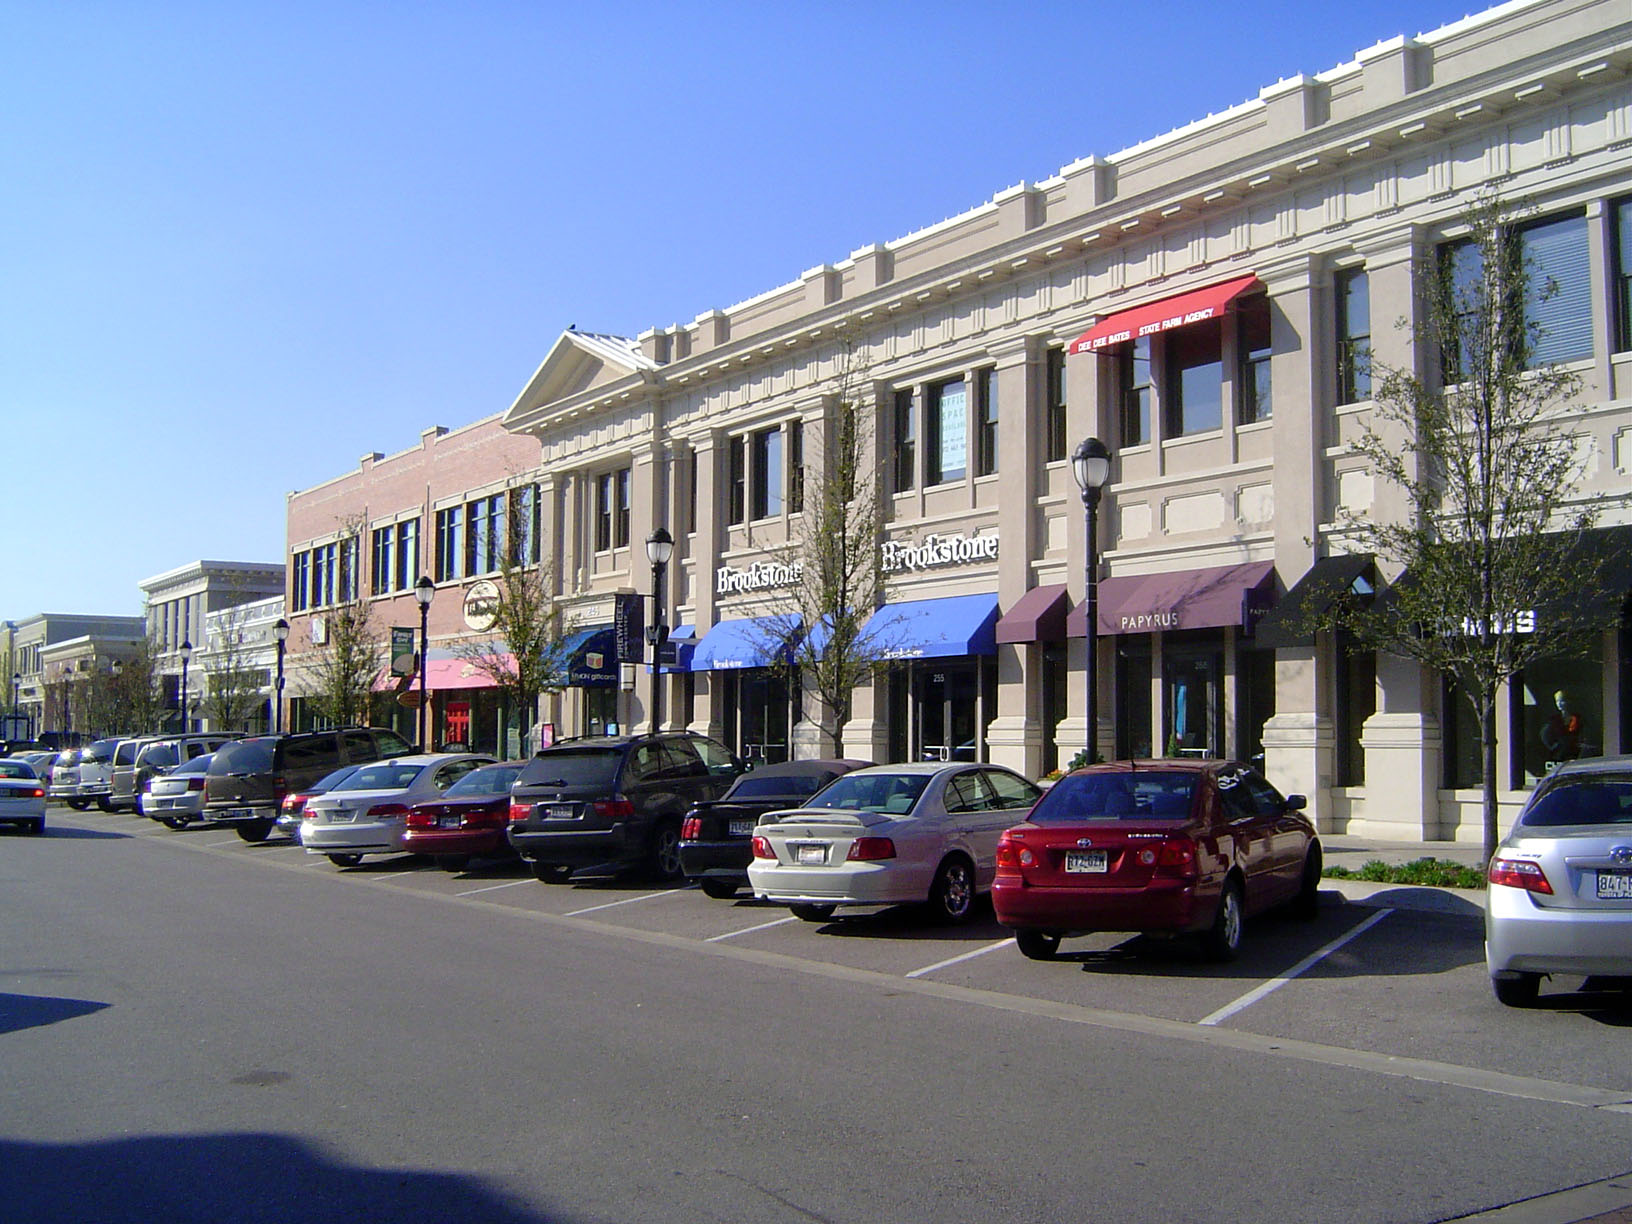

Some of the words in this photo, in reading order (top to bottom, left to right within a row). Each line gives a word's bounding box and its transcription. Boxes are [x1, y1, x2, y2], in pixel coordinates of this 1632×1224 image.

[1078, 342, 1092, 352] DEE
[1093, 337, 1107, 348] DEE
[1108, 330, 1131, 345] BATES
[1138, 322, 1161, 336] STATE
[1161, 316, 1182, 330] FARM
[1183, 308, 1214, 325] AGENCY
[881, 534, 1000, 573] Brookstone
[717, 564, 803, 593] Brookstone
[616, 600, 624, 659] FIREWHEEL
[1121, 612, 1178, 630] PAPYRUS
[933, 673, 945, 683] 255
